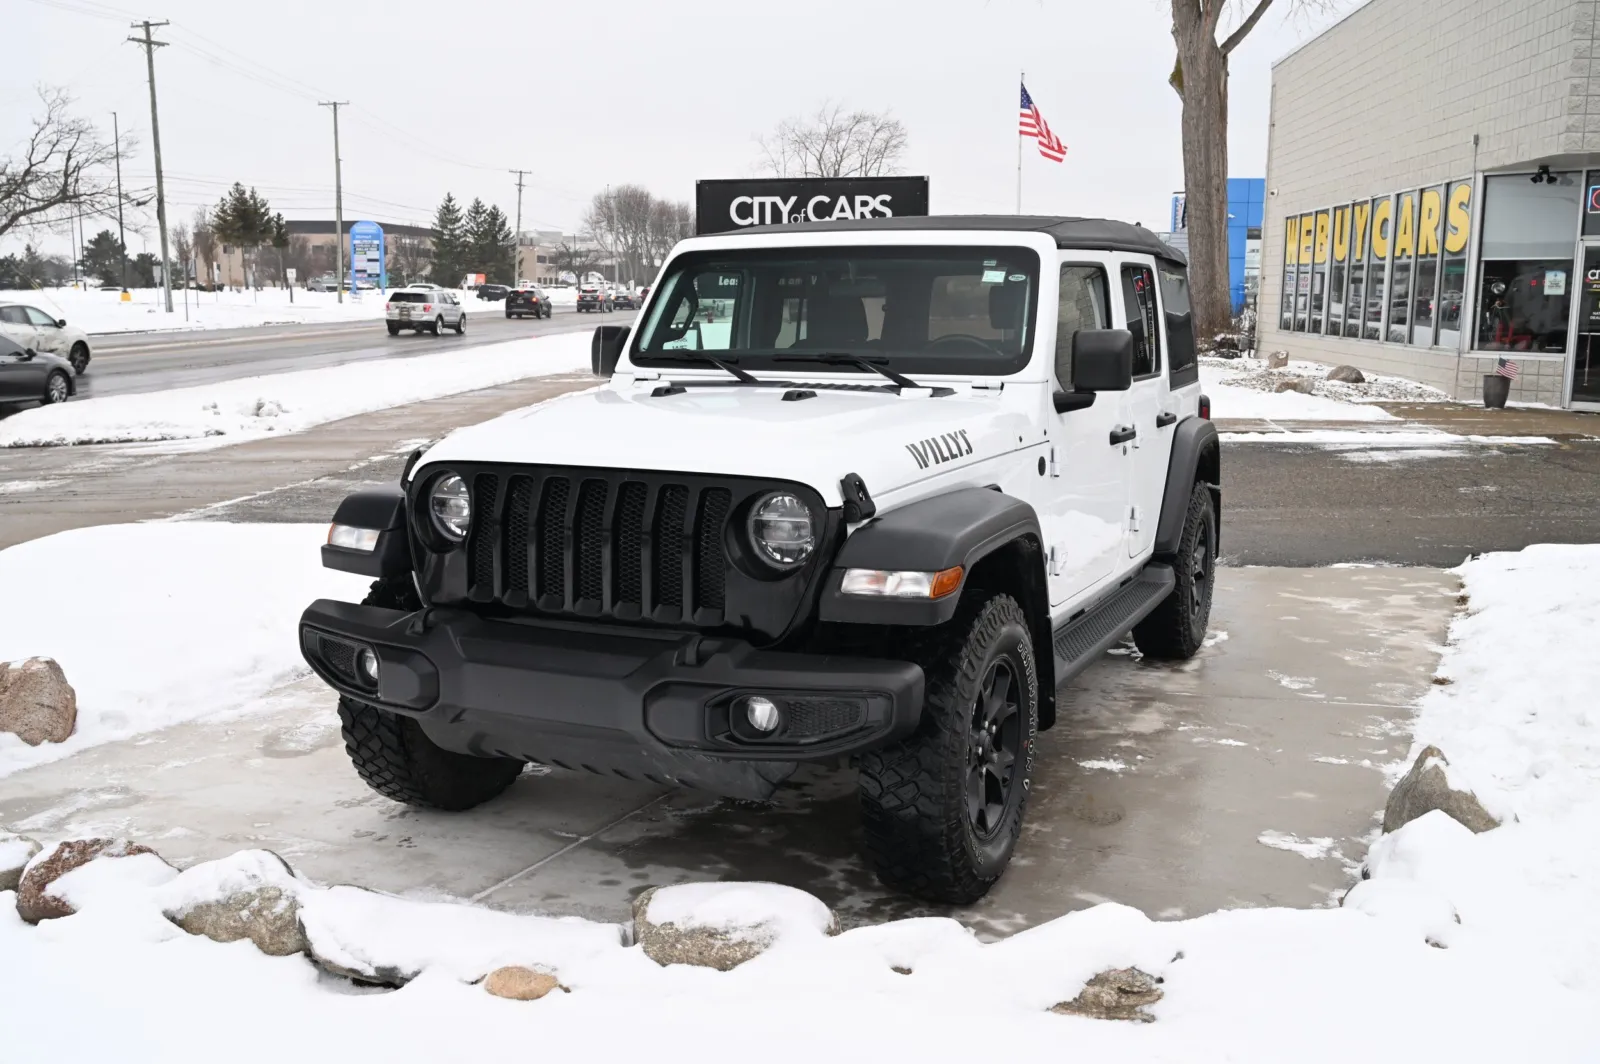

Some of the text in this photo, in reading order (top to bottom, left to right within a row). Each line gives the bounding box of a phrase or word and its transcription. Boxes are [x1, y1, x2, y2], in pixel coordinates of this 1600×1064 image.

[729, 194, 893, 226] CITY of CARS
[1286, 184, 1471, 264] WE BUY CARS
[1016, 638, 1037, 773] DESTINATION
